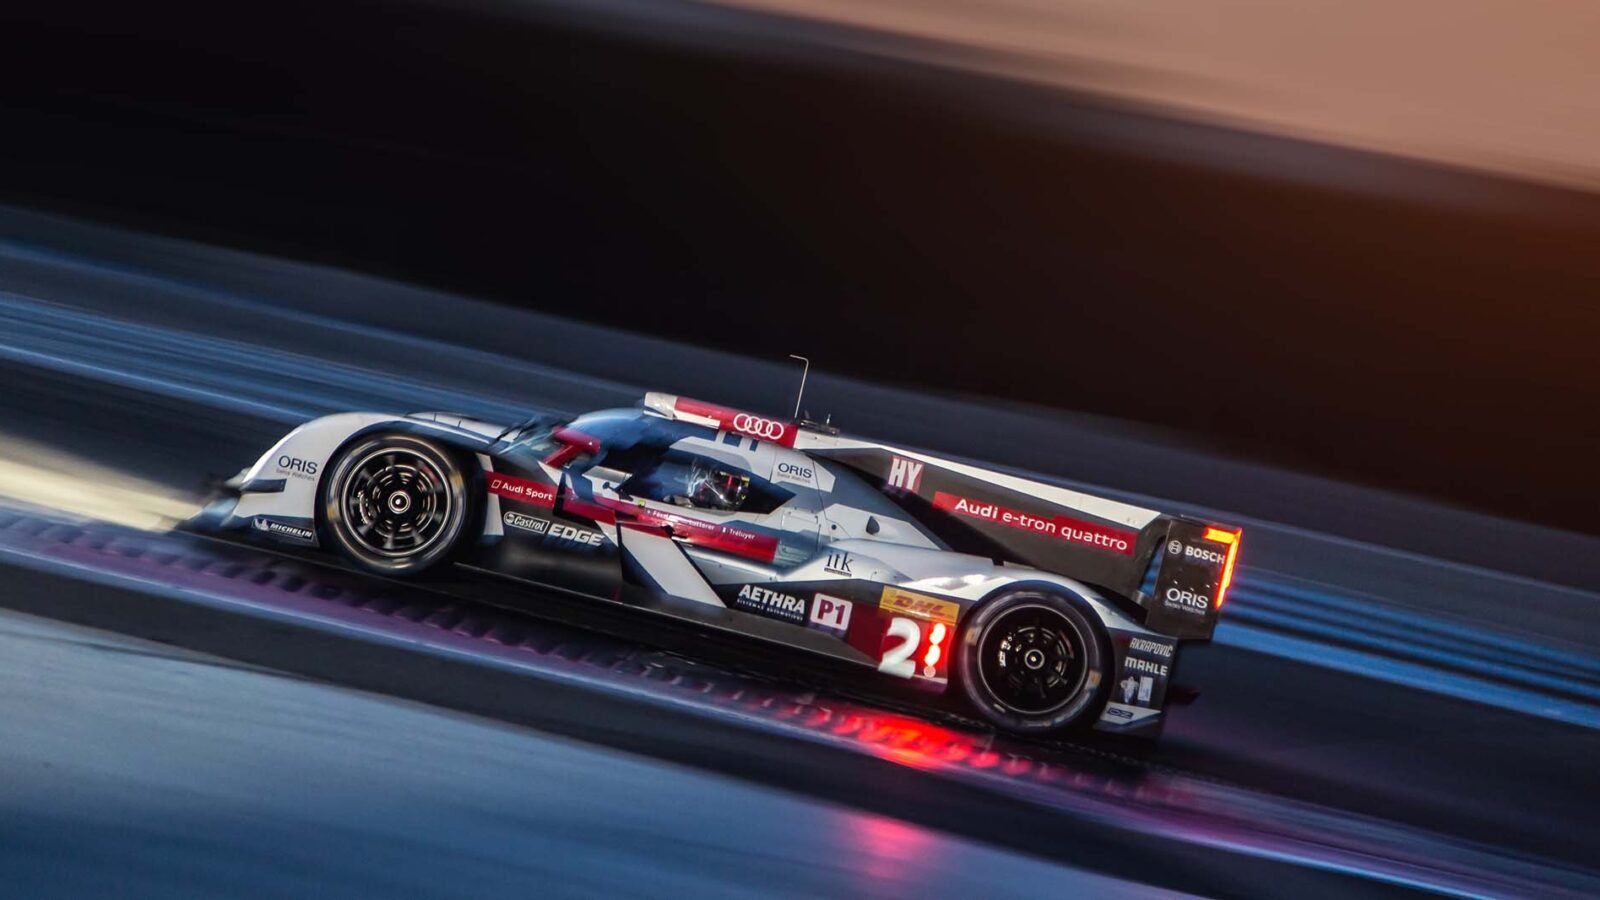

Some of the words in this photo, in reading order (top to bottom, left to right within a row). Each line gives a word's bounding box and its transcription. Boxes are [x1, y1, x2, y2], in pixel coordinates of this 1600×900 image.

[278, 455, 318, 475] ORIS
[778, 462, 813, 479] ORIS
[888, 458, 922, 491] HY
[502, 482, 524, 494] Audi
[525, 487, 553, 502] Sport
[270, 523, 312, 537] MICHELIN
[514, 516, 546, 532] Castrol
[547, 523, 605, 546] EDGE
[955, 498, 998, 519] Audi
[1002, 511, 1056, 533] e-tron
[1060, 526, 1128, 551] quattro
[1185, 545, 1226, 564] BOSCH
[738, 584, 805, 614] AETHRA
[1166, 588, 1209, 609] ORIS
[817, 599, 846, 625] P1
[878, 617, 920, 679] 2
[1124, 656, 1168, 676] MAHLE
